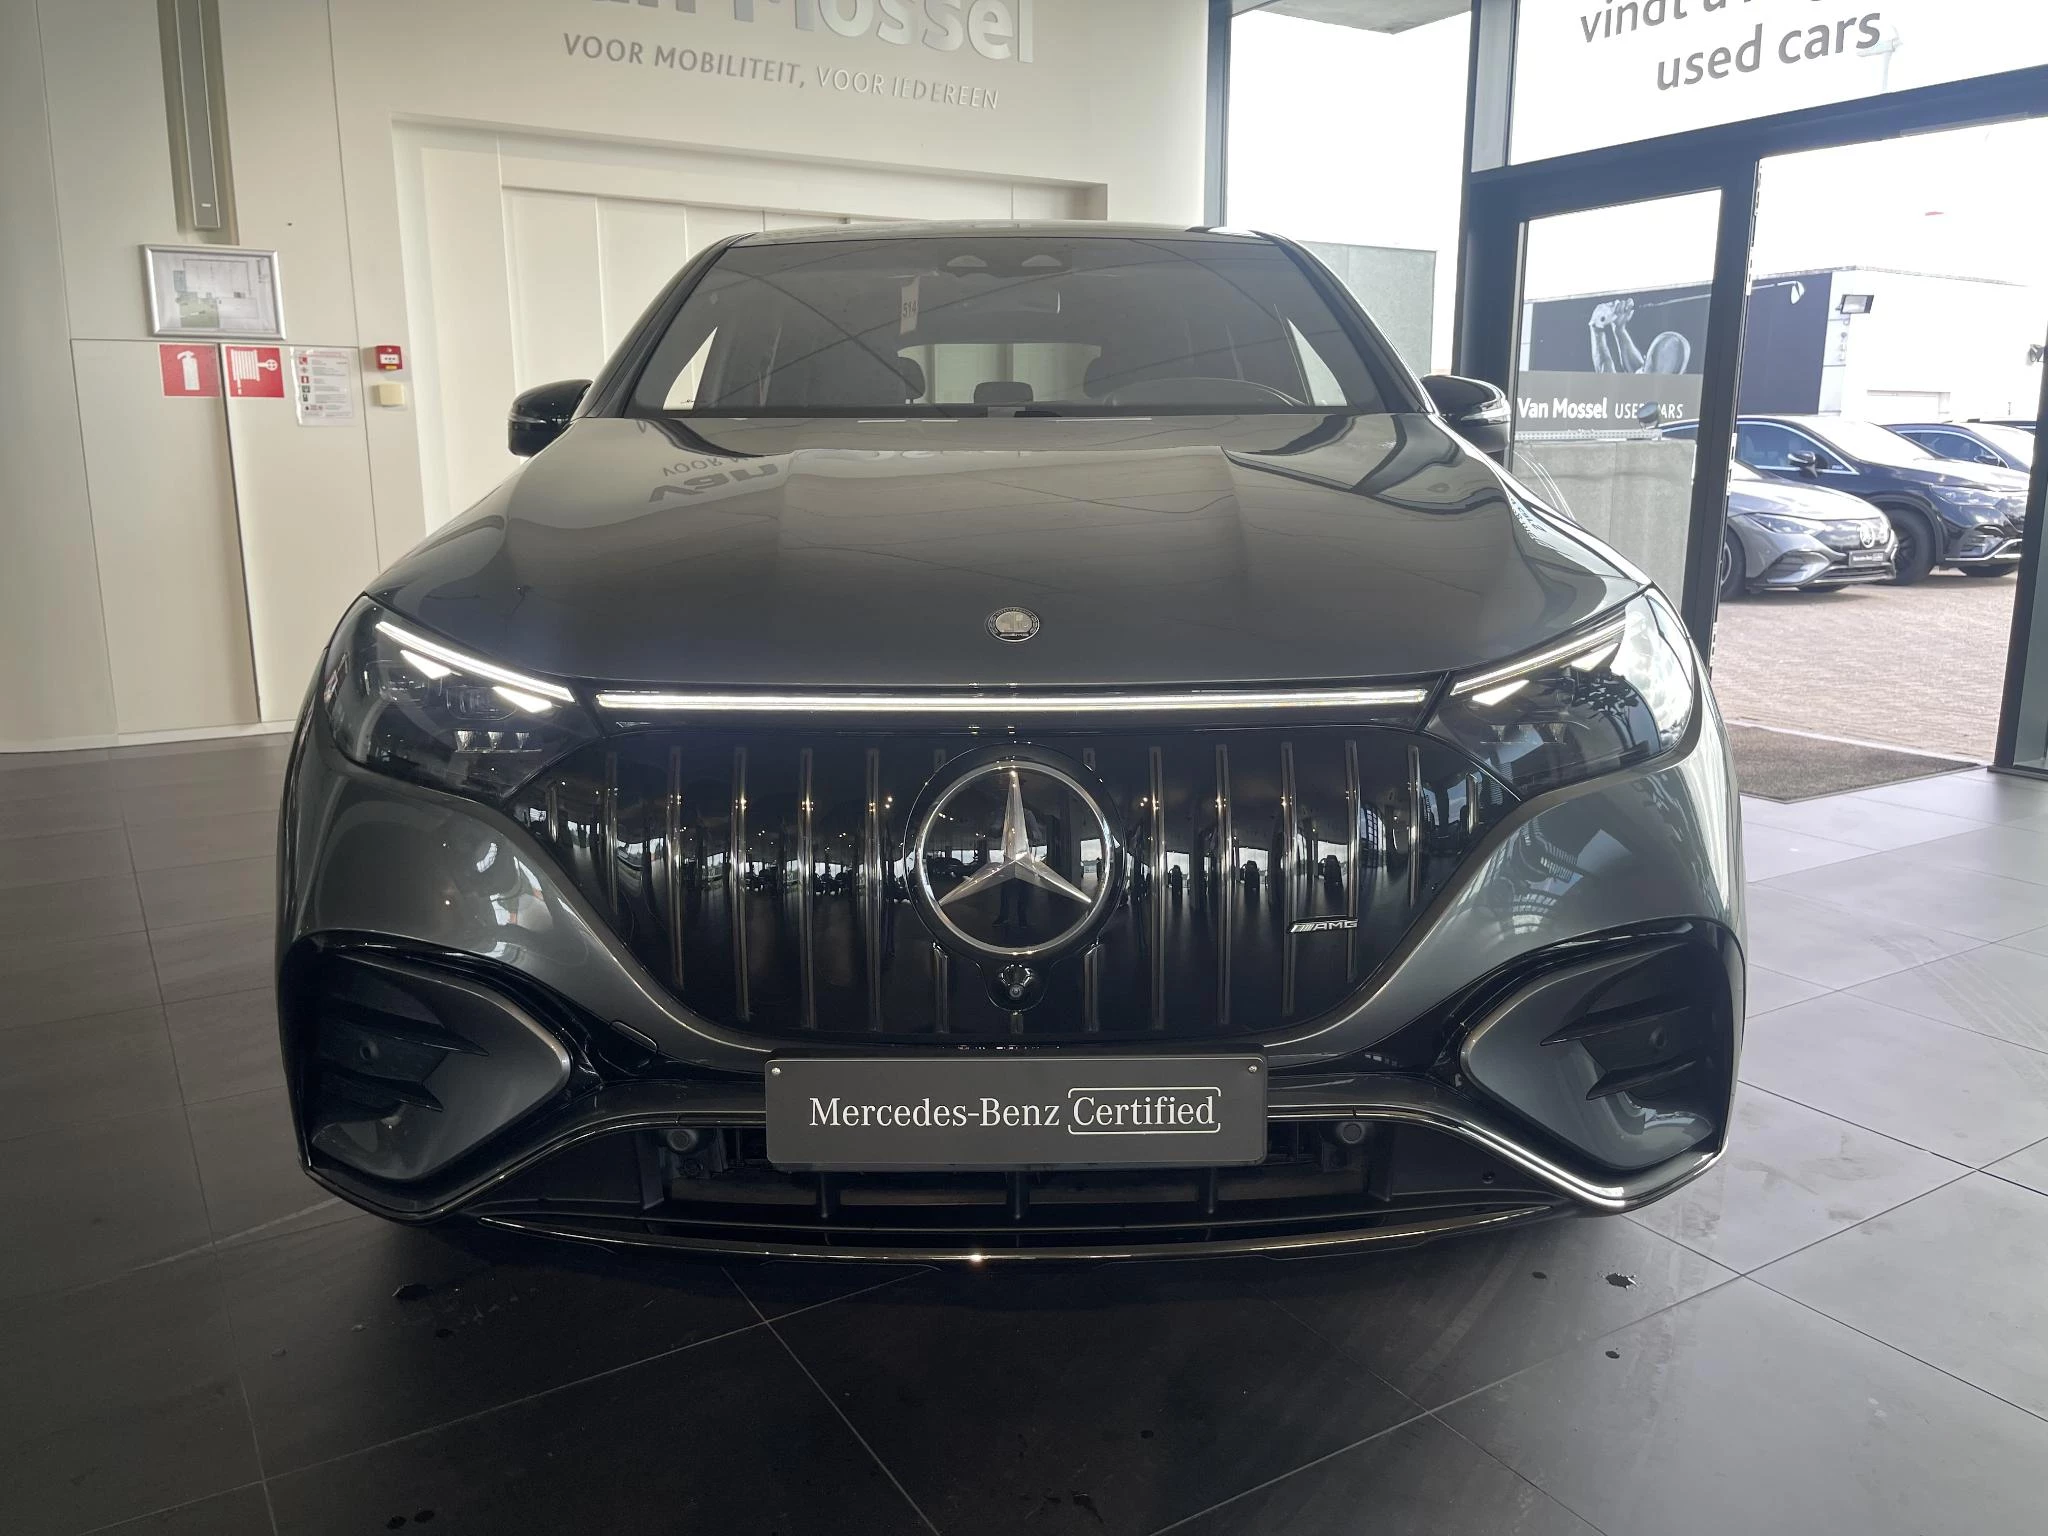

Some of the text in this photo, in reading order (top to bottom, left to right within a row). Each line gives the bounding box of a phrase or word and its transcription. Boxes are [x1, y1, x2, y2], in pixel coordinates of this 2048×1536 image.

[1657, 12, 1881, 91] used cars
[563, 32, 999, 110] VOOR MOBILITEIT, VOOR IEDEREEN
[1517, 397, 1684, 419] Van Mossel USE ARS
[1308, 919, 1358, 932] AMG
[809, 1095, 1216, 1128] Mercedes-Benz Certified
